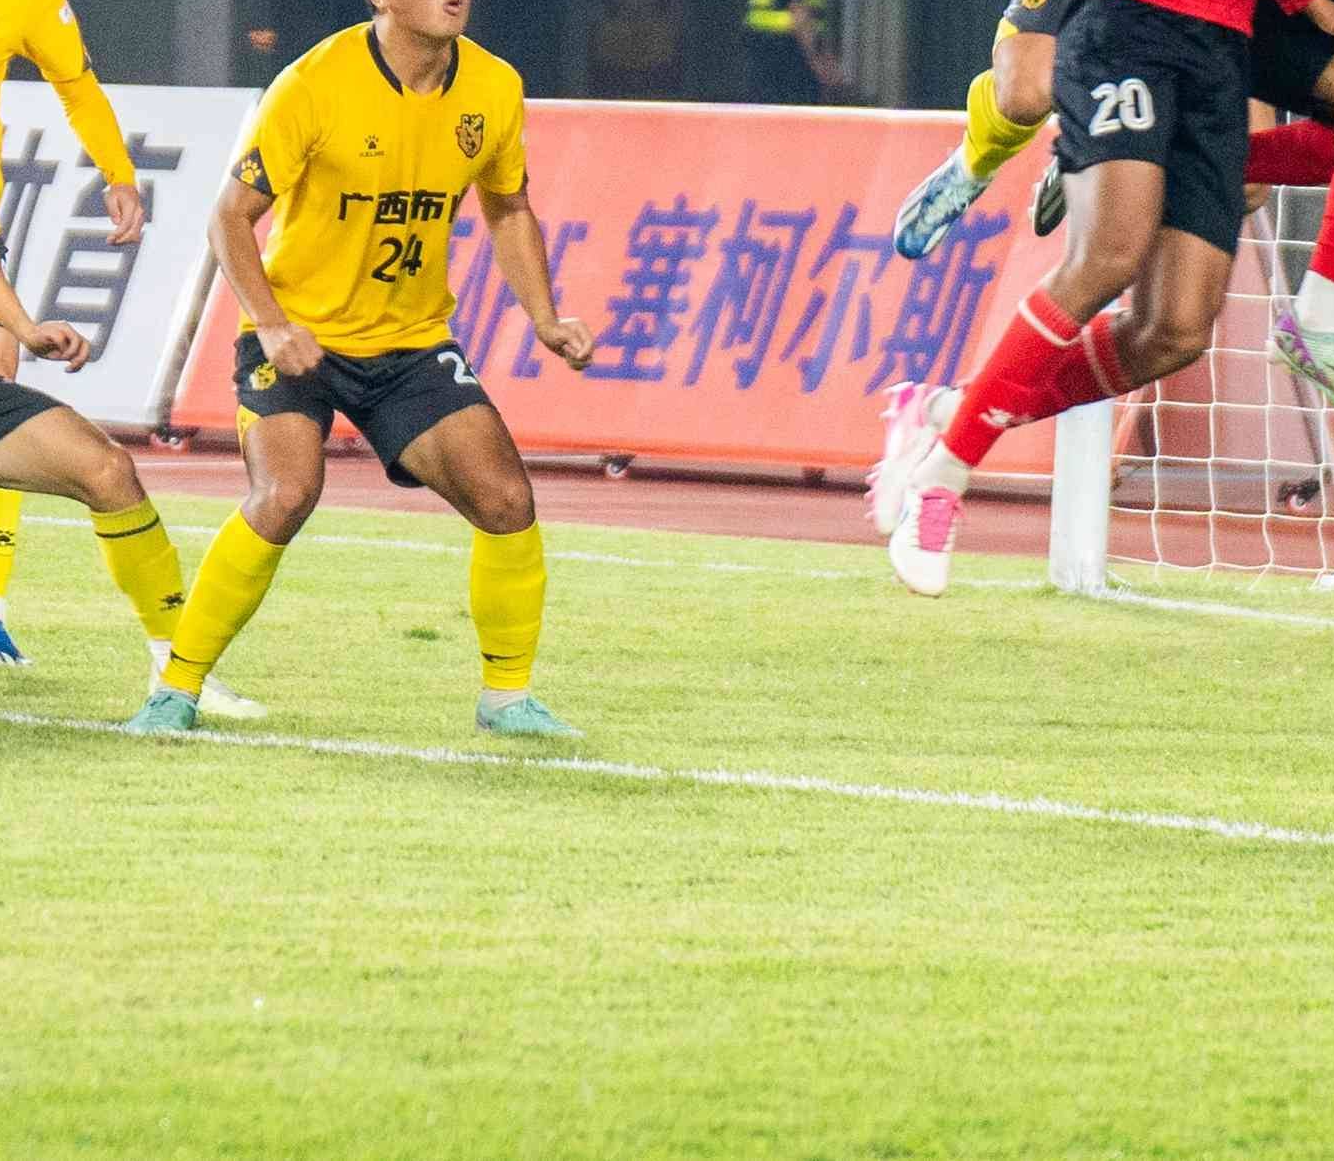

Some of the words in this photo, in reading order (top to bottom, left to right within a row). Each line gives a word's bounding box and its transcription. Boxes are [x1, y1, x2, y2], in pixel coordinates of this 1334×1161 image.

[1089, 77, 1155, 136] 20
[371, 234, 423, 283] 24
[582, 193, 1010, 397] 塞柯尔斯
[437, 350, 478, 384] 2
